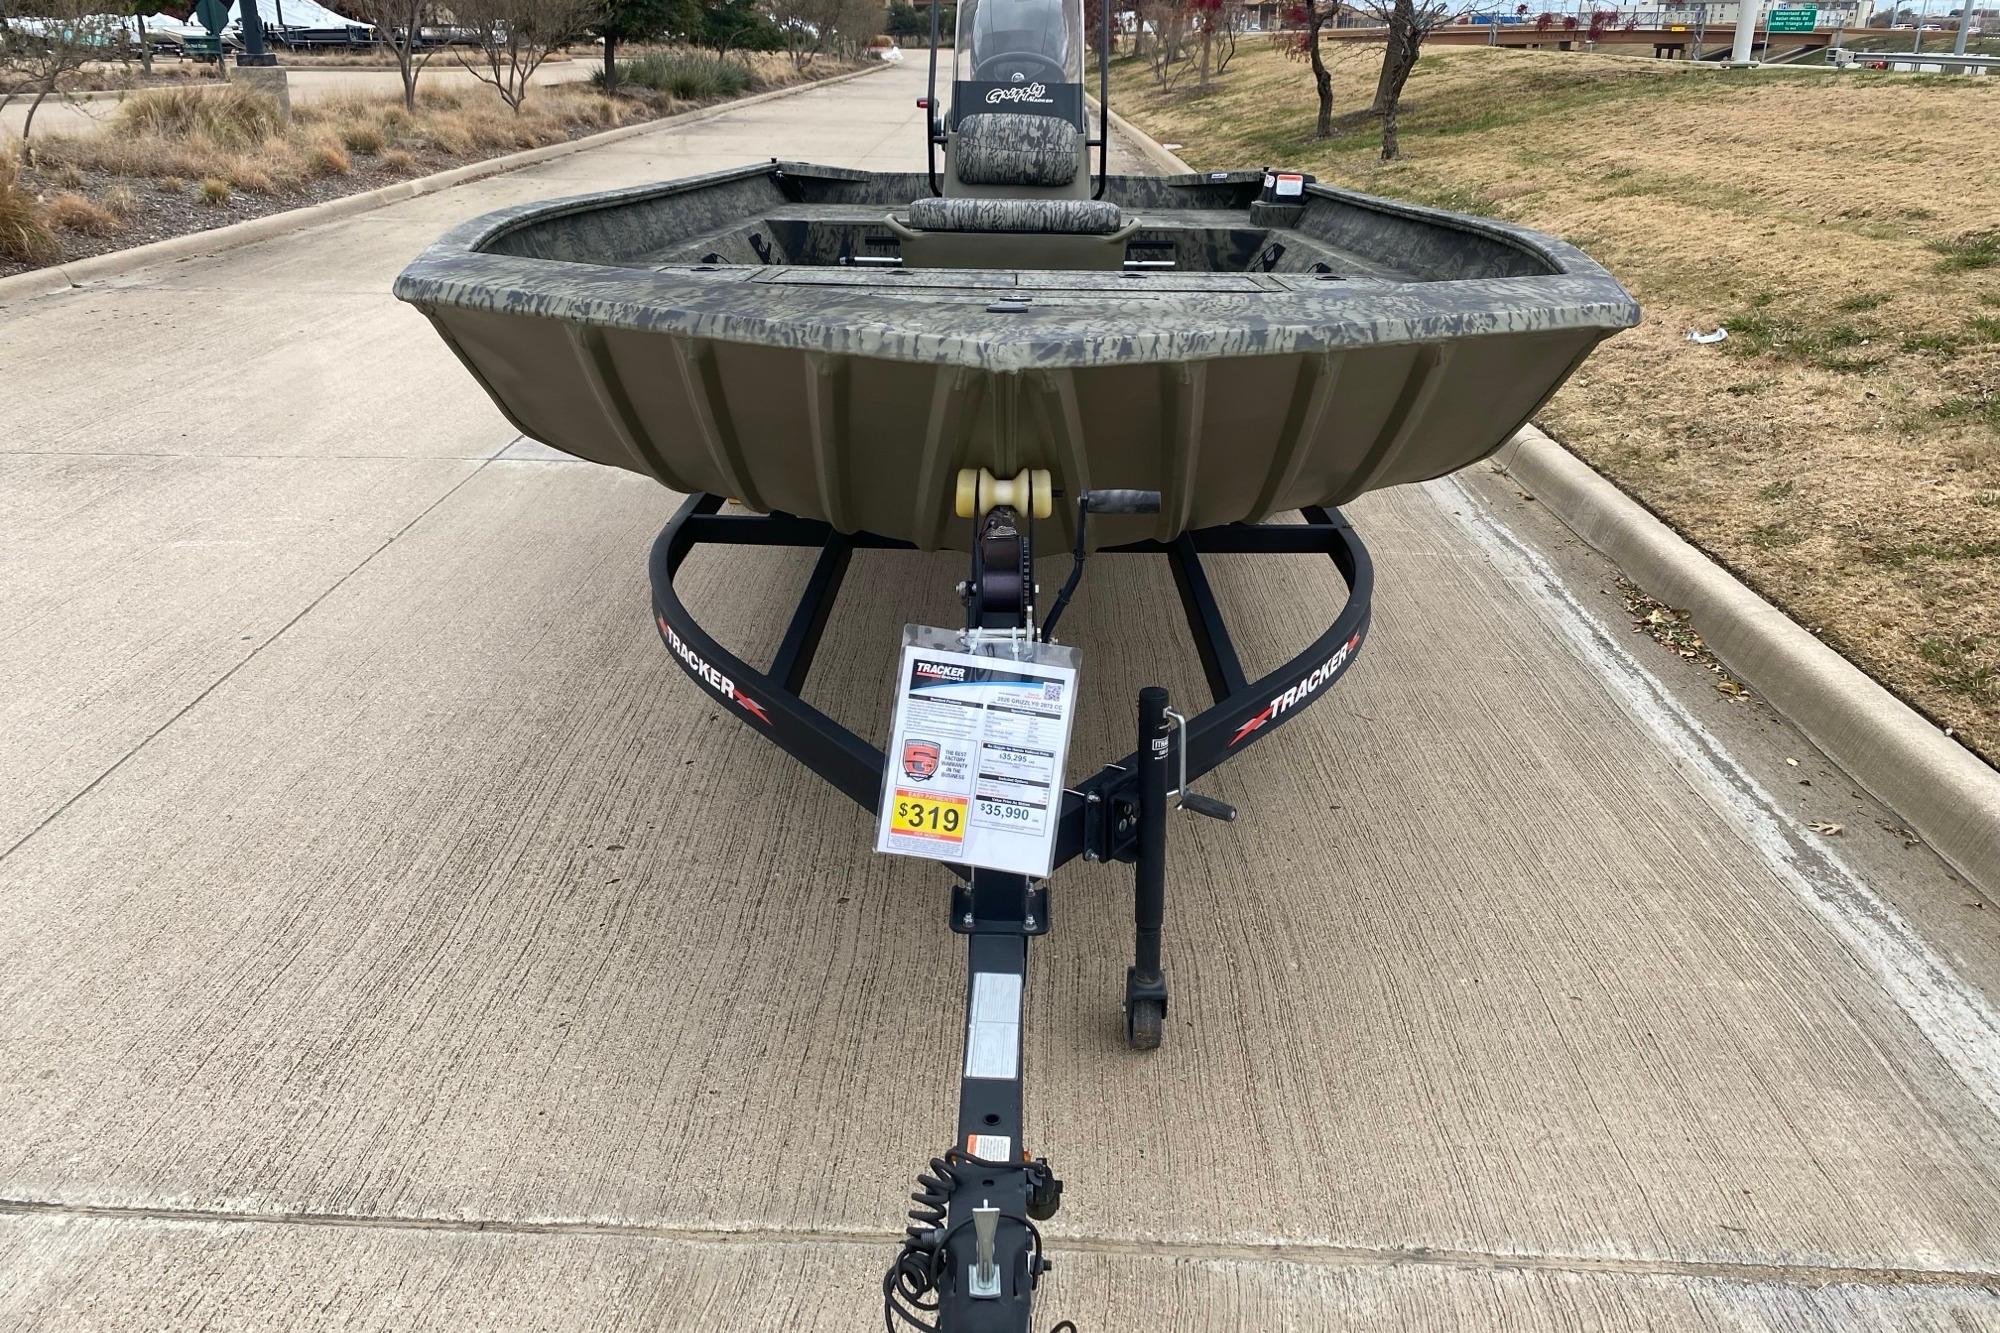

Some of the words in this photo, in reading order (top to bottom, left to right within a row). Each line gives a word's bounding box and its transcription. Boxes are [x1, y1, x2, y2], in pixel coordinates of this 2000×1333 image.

[667, 624, 735, 700] TRACKER
[917, 662, 965, 678] TRACKER
[1270, 642, 1348, 719] TRACKER
[1000, 752, 1027, 762] $35,295
[898, 802, 959, 832] $319
[980, 803, 1029, 820] $35,990
